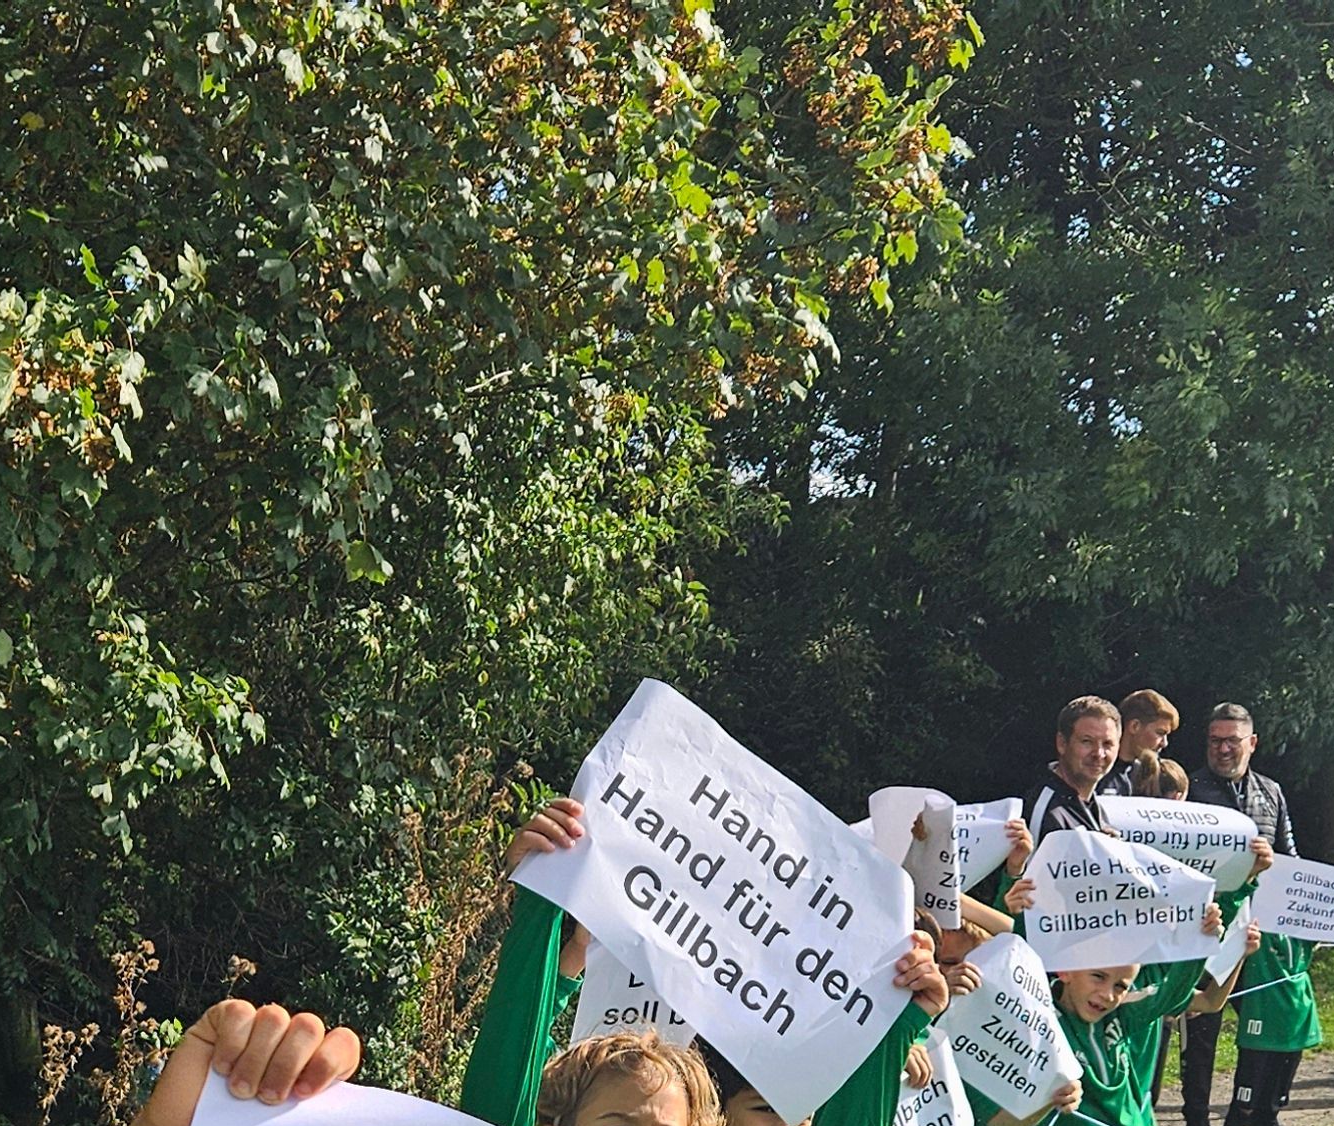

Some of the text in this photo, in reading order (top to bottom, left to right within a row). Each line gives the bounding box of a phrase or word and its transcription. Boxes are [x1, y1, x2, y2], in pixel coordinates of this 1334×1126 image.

[1138, 808, 1220, 826] Gillbach
[689, 775, 855, 930] Hand in
[1161, 831, 1190, 850] für
[1196, 833, 1247, 853] Hand
[1047, 860, 1101, 880] Viele
[600, 772, 874, 1026] Hand für den
[1075, 886, 1108, 904] ein
[1039, 909, 1127, 933] Gillbach
[1135, 904, 1195, 925] bleibt
[624, 865, 796, 1036] Gillbach
[1013, 966, 1051, 1007] Gillba
[603, 1001, 659, 1025] soll
[995, 991, 1055, 1044] erhalten
[981, 1015, 1049, 1071] Zukunft
[952, 1034, 1037, 1098] gestalten
